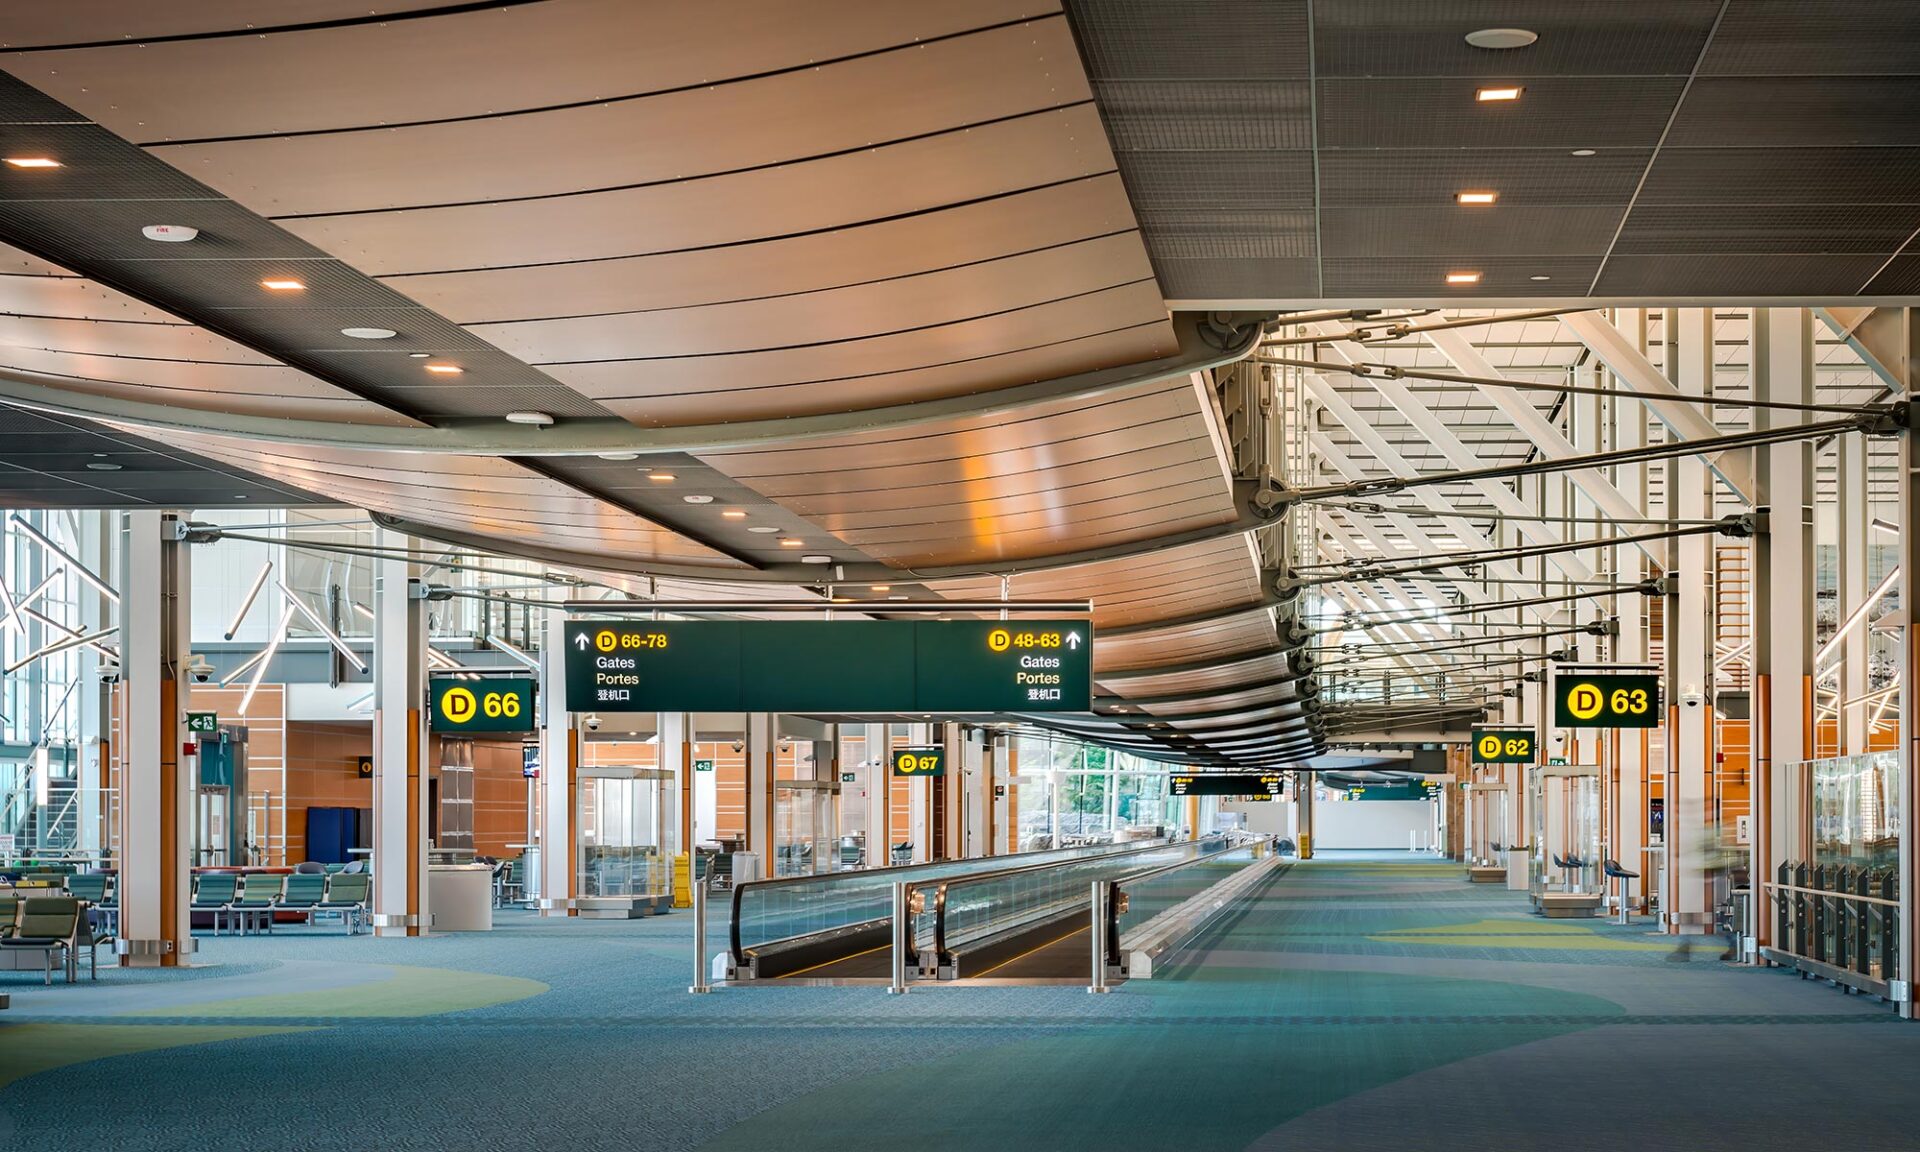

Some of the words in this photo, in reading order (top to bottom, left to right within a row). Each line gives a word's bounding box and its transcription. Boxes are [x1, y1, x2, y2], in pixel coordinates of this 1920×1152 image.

[602, 635, 613, 647] D
[621, 634, 667, 648] 66-78
[995, 634, 1006, 646] D
[1013, 633, 1061, 648] 48-63
[596, 656, 635, 669] Gates
[1020, 655, 1060, 668] Gates
[596, 672, 639, 685] Portes
[1016, 671, 1060, 685] Portes
[597, 689, 630, 700] 登机口
[1027, 688, 1060, 700] 登机口
[451, 694, 470, 715] D
[483, 692, 520, 718] 66
[1577, 691, 1596, 711] D
[1610, 689, 1648, 714] 63
[1485, 741, 1497, 753] D
[1505, 739, 1529, 756] 62
[903, 758, 912, 769] D
[919, 756, 938, 770] 67
